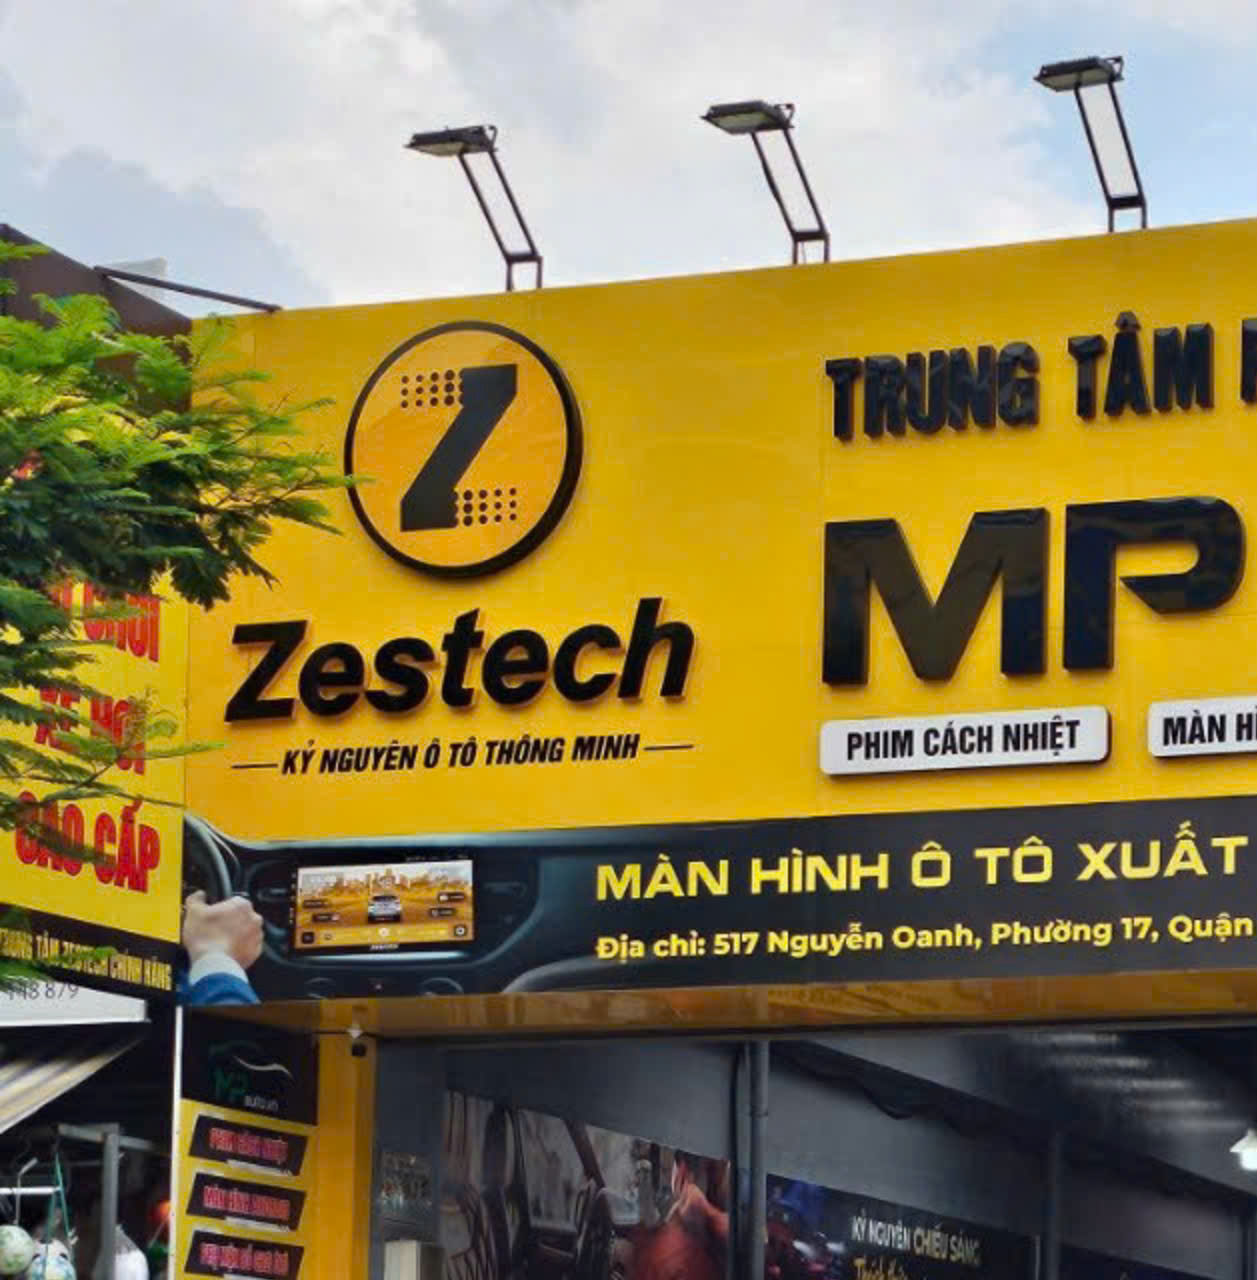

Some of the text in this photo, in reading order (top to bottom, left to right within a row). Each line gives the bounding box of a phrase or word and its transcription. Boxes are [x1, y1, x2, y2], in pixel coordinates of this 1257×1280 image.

[825, 341, 1040, 442] TRUNG
[1067, 311, 1215, 421] TÂM
[822, 494, 1248, 687] MP
[224, 596, 696, 723] Zestech
[281, 732, 641, 776] KỶ NGUYÊN Ô TÔ THÔNG MINH
[846, 714, 1081, 762] PHIM CÁCH NHIỆT
[1162, 711, 1227, 748] MÀN
[94, 794, 161, 893] CẤP
[596, 853, 730, 902] MÀN
[750, 848, 889, 895] HÌNH
[910, 841, 952, 888] Ô
[975, 836, 1053, 885] TÔ
[1076, 820, 1248, 881] XUẤT
[596, 934, 646, 965] Địa
[653, 929, 706, 958] chỉ:
[713, 930, 759, 956] 517
[767, 921, 882, 962] Nguyễn
[892, 921, 983, 951] Oanh,
[991, 914, 1113, 949] Phường
[1122, 916, 1159, 945] 17,
[1167, 910, 1254, 944] Quận
